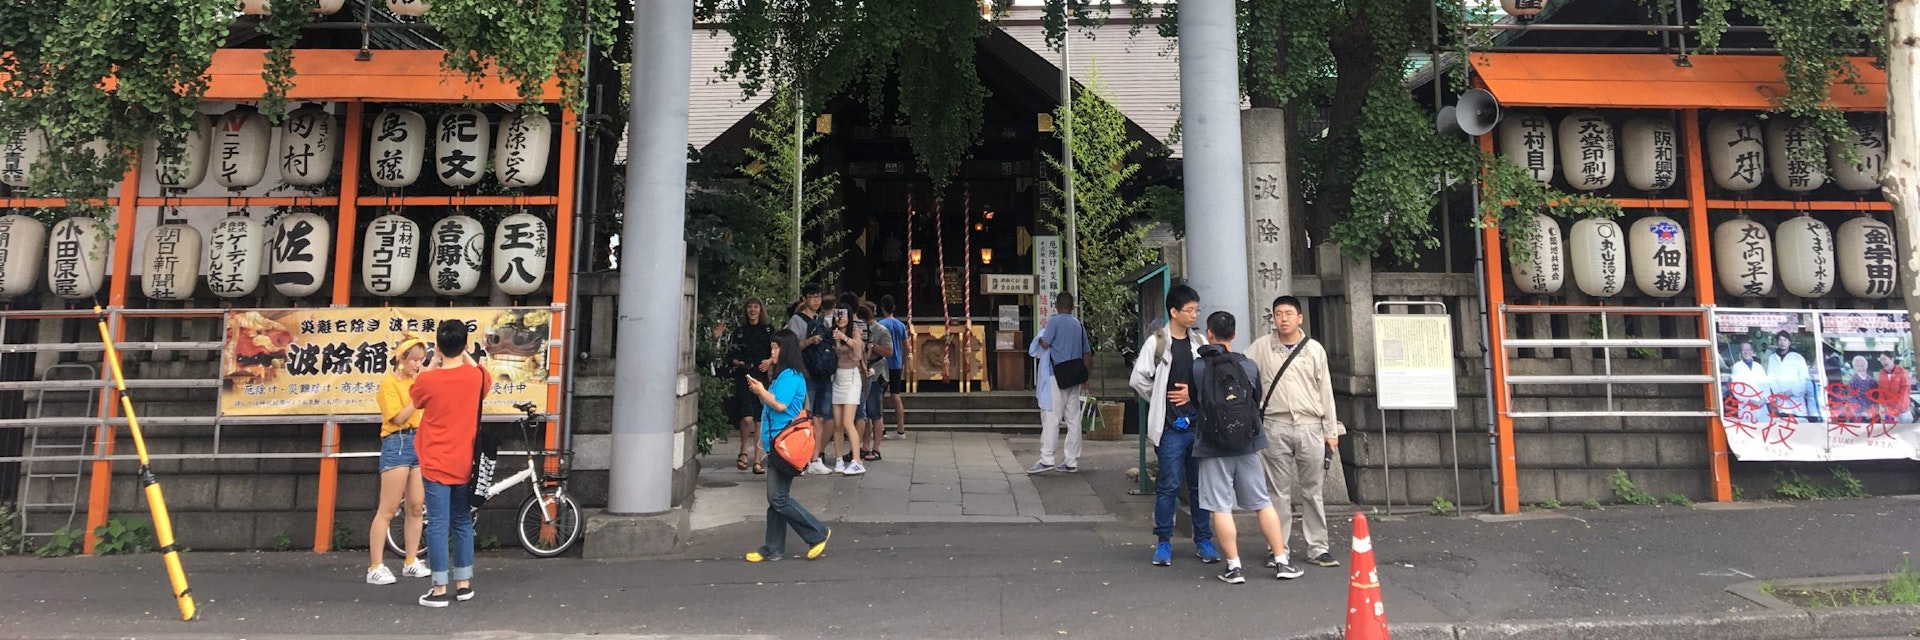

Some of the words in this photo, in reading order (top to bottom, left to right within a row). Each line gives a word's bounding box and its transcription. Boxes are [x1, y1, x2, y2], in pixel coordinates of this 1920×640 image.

[221, 134, 240, 183] ニチレイ
[283, 114, 315, 178] 田村
[440, 113, 478, 180] 紀文
[1521, 118, 1546, 183] 中村自工
[1650, 130, 1674, 188] 阪和興業
[54, 221, 81, 297] 小田原屋
[151, 227, 181, 299] 朝日新聞社
[226, 234, 247, 293] ケーディーエム
[271, 220, 315, 286] 佐一
[371, 220, 398, 293] ジョウコウ
[397, 221, 413, 258] 石材店
[437, 221, 465, 291] 吉野家
[499, 222, 537, 285] 玉八
[1049, 241, 1058, 317] 厄除け・災難除け・
[301, 319, 381, 334] 災難を除き
[389, 317, 478, 332] 波を乗る
[244, 382, 381, 396] 厄除け・災難除け・商売繁
[490, 383, 527, 395] 受付中
[286, 340, 487, 377] 波除稲
